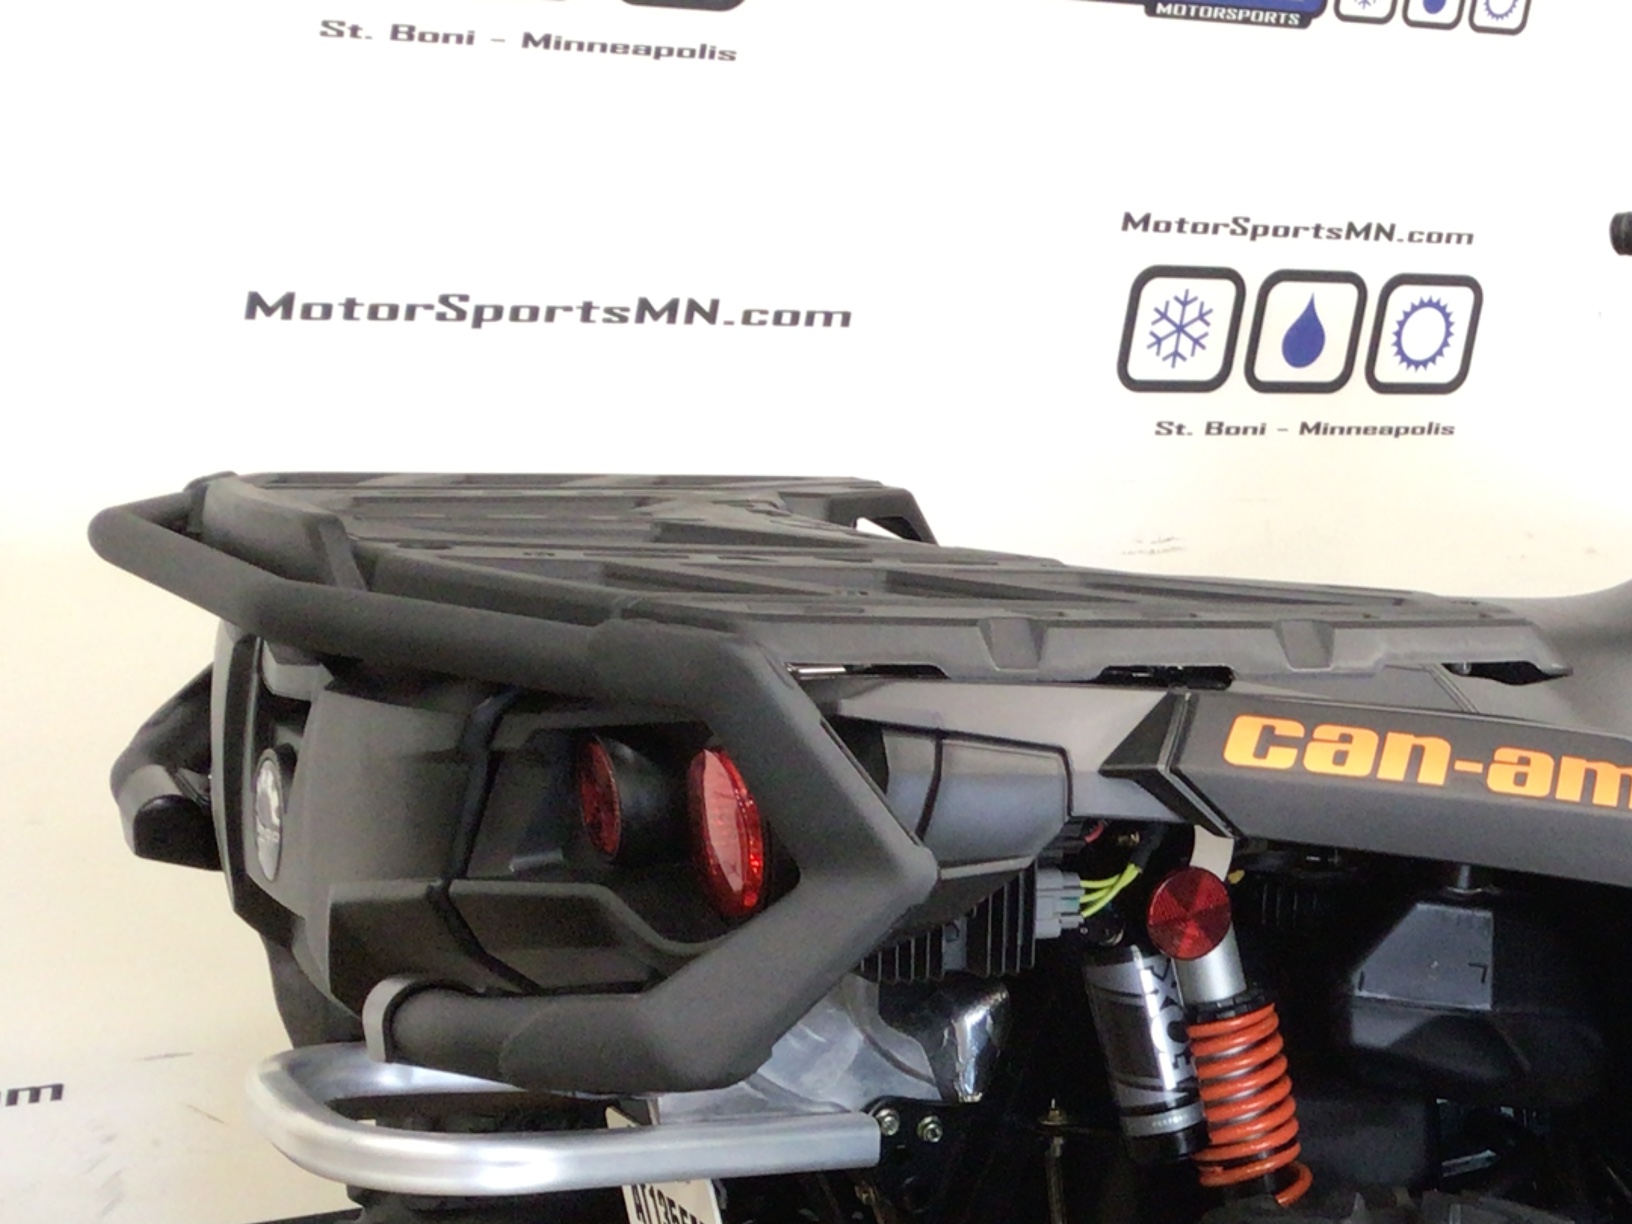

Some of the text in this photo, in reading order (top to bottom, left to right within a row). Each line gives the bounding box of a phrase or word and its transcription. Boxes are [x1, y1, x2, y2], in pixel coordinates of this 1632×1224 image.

[1155, 2, 1300, 26] MOTORSPORTS
[319, 20, 371, 39] St.
[390, 23, 475, 46] Boni
[521, 31, 737, 61] Minneapolis
[1121, 211, 1475, 245] MotorSportsMN.com
[244, 291, 852, 329] MotorSportsMN.com
[1154, 421, 1193, 436] St.
[1204, 421, 1267, 436] Boni
[1299, 421, 1456, 439] Minneapolis
